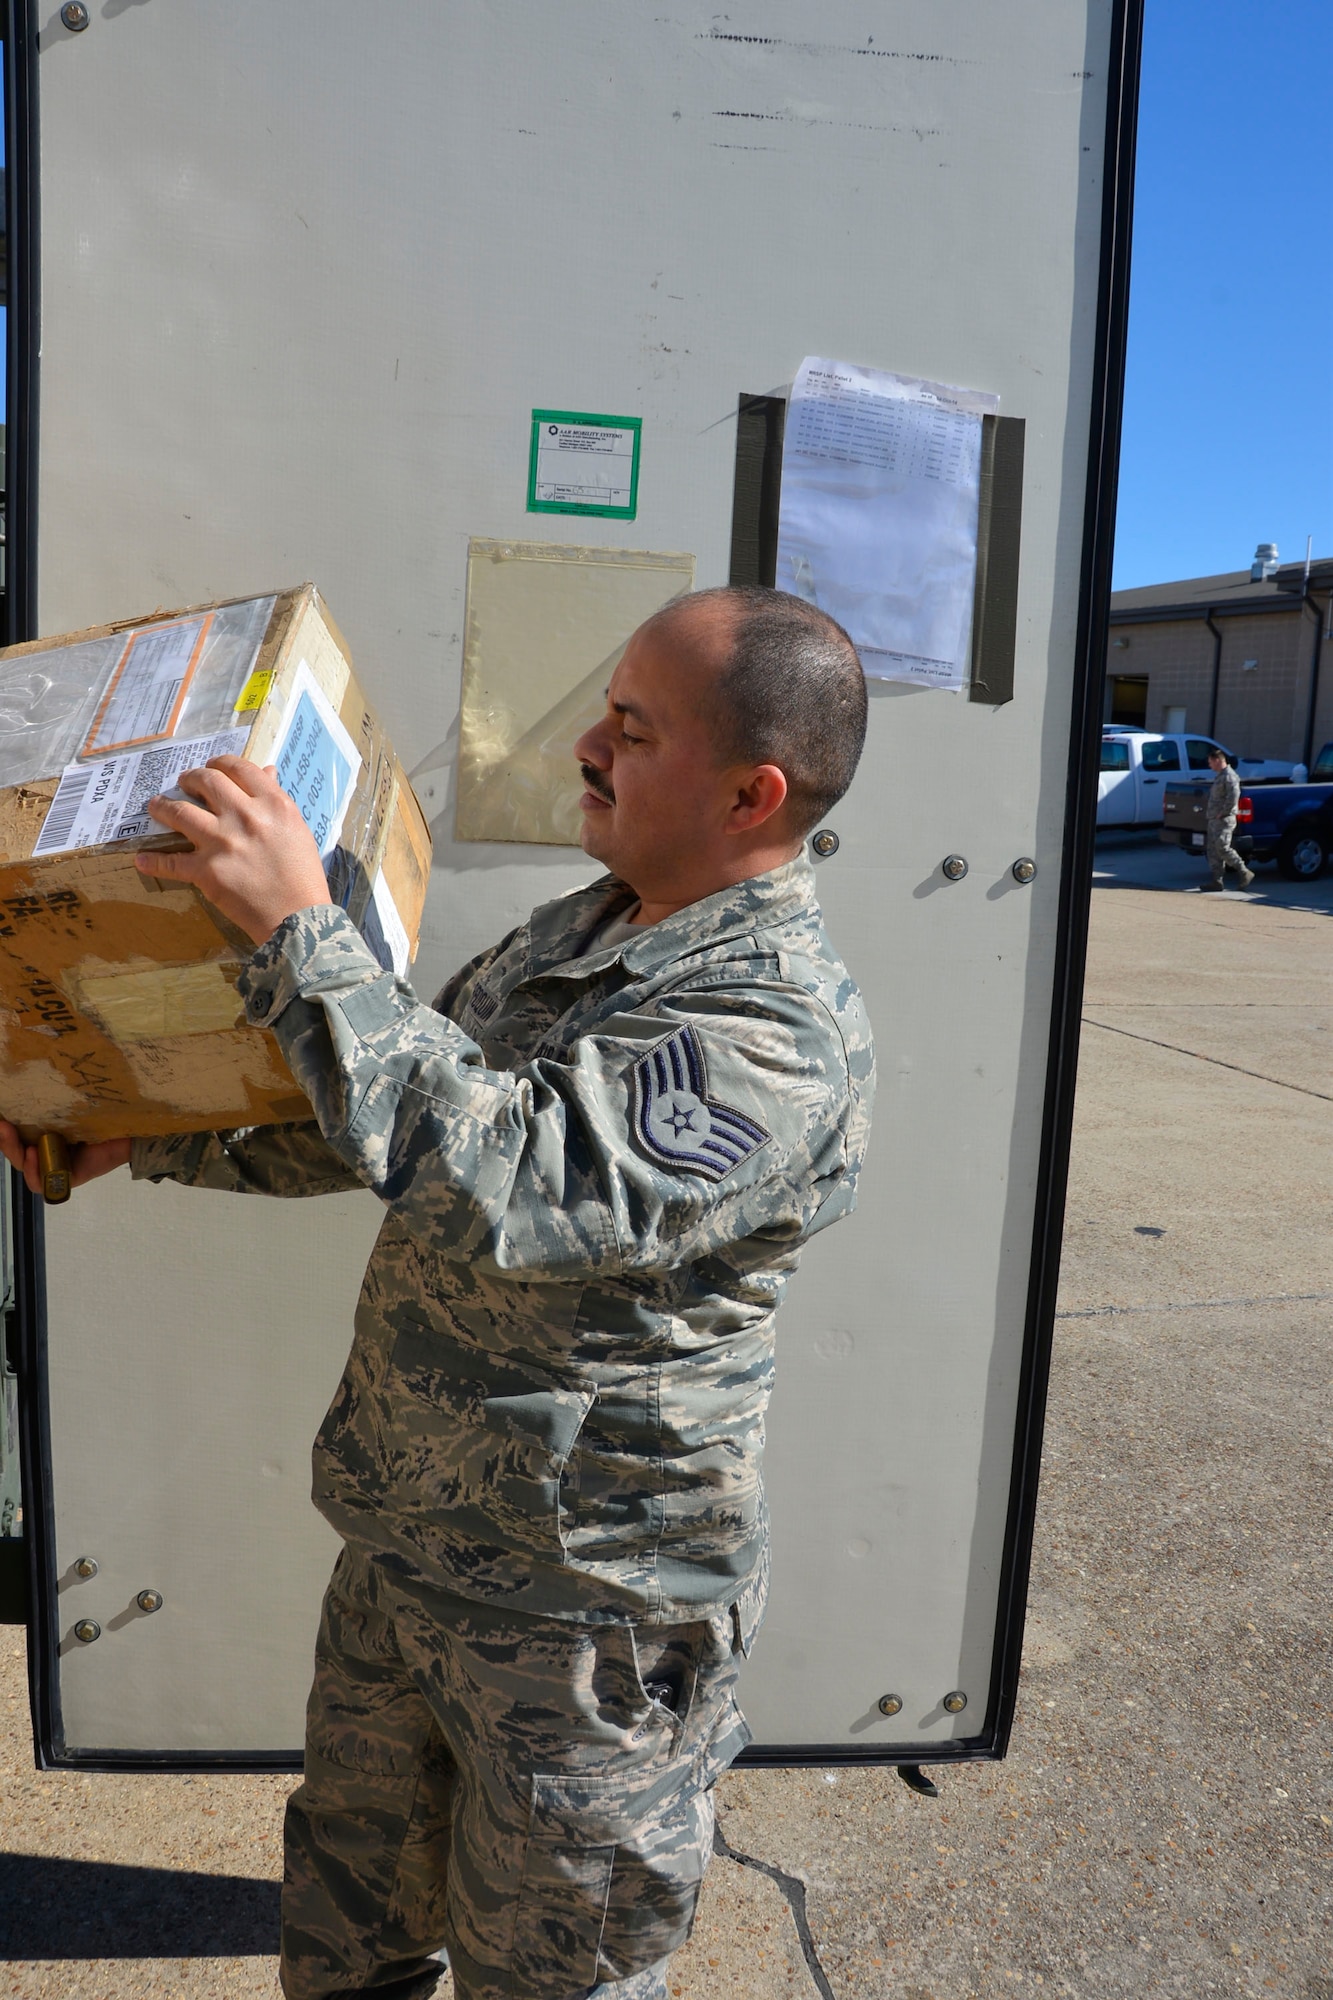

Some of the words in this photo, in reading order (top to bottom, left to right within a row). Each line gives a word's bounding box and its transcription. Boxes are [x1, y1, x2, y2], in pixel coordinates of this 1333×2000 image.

[279, 757, 292, 775] FW
[287, 714, 305, 751] MRSP
[101, 760, 117, 777] WS
[90, 778, 110, 804] PDXA
[307, 768, 326, 810] 0034
[142, 817, 151, 834] FedEx
